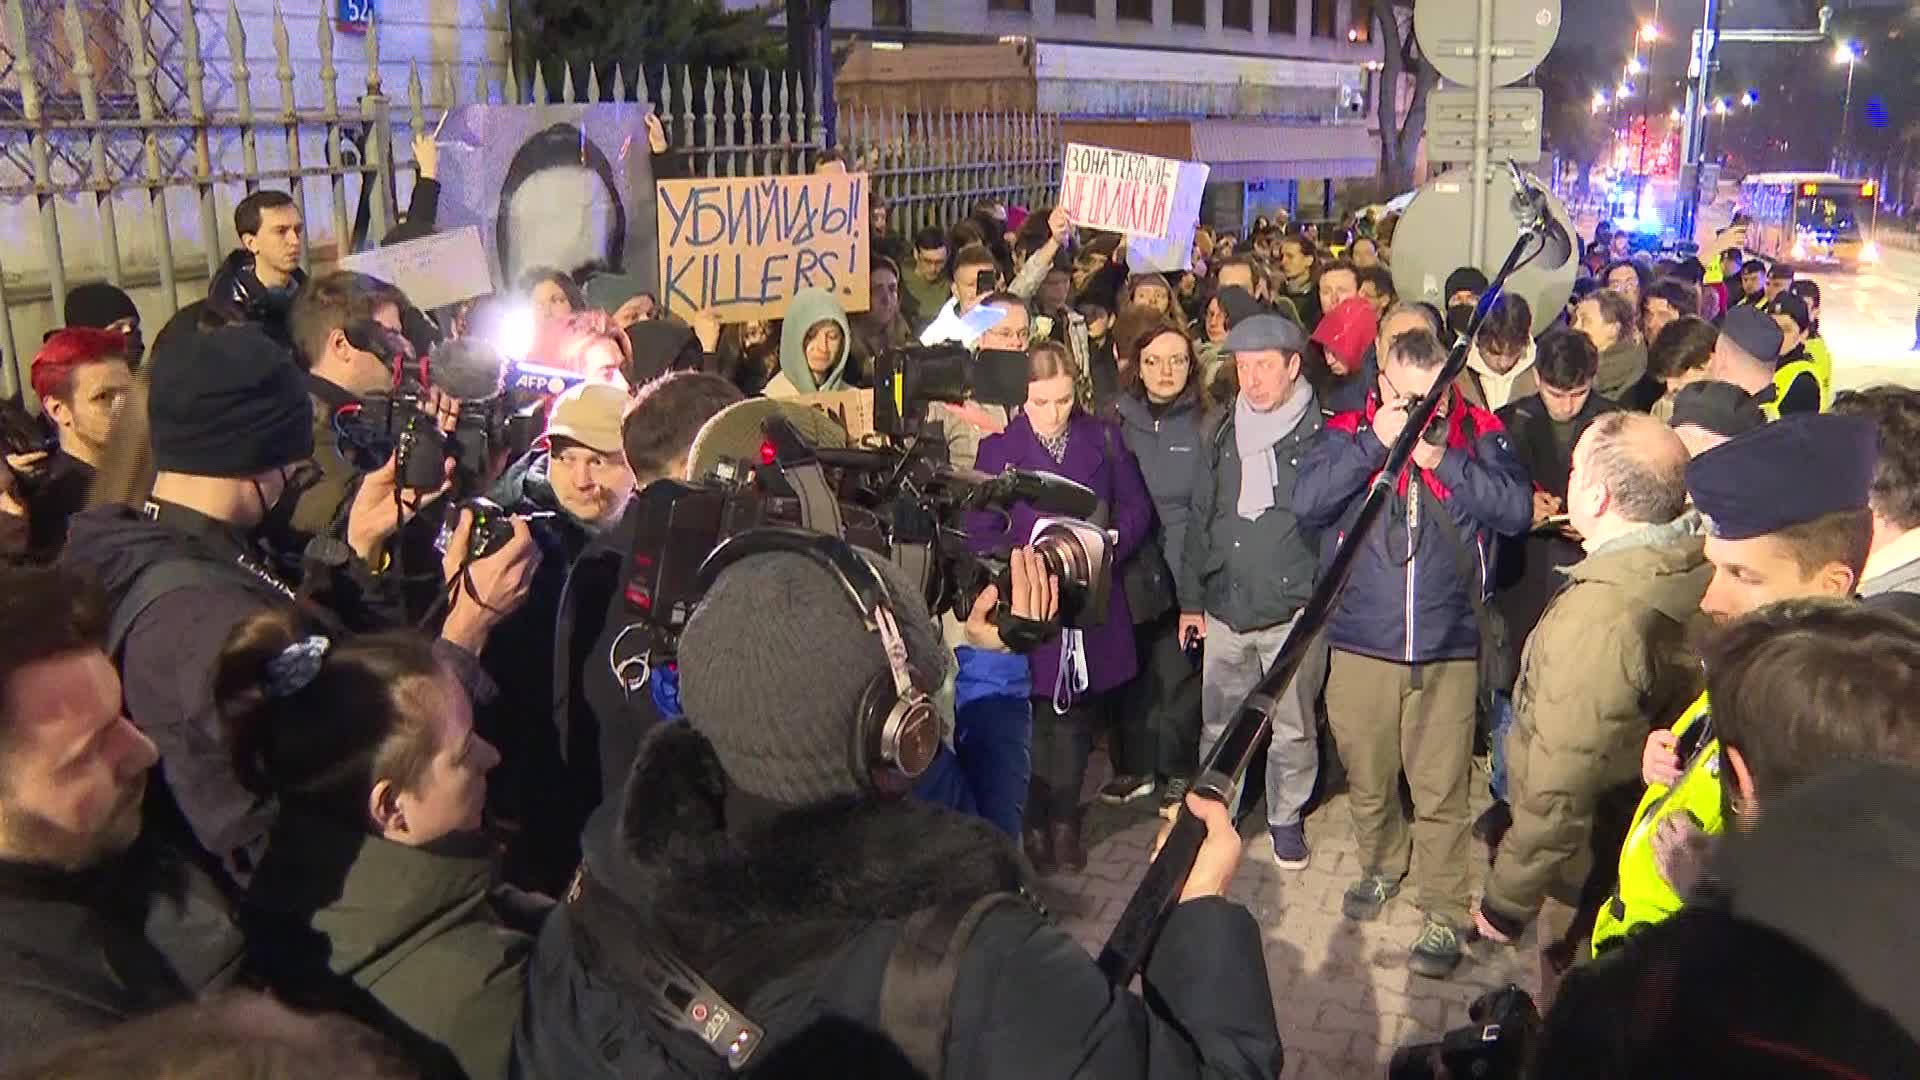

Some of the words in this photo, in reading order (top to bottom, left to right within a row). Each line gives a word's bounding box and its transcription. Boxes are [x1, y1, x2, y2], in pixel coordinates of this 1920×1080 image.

[349, 0, 368, 21] 52
[664, 243, 856, 315] KILLERS!
[516, 375, 548, 390] AFP
